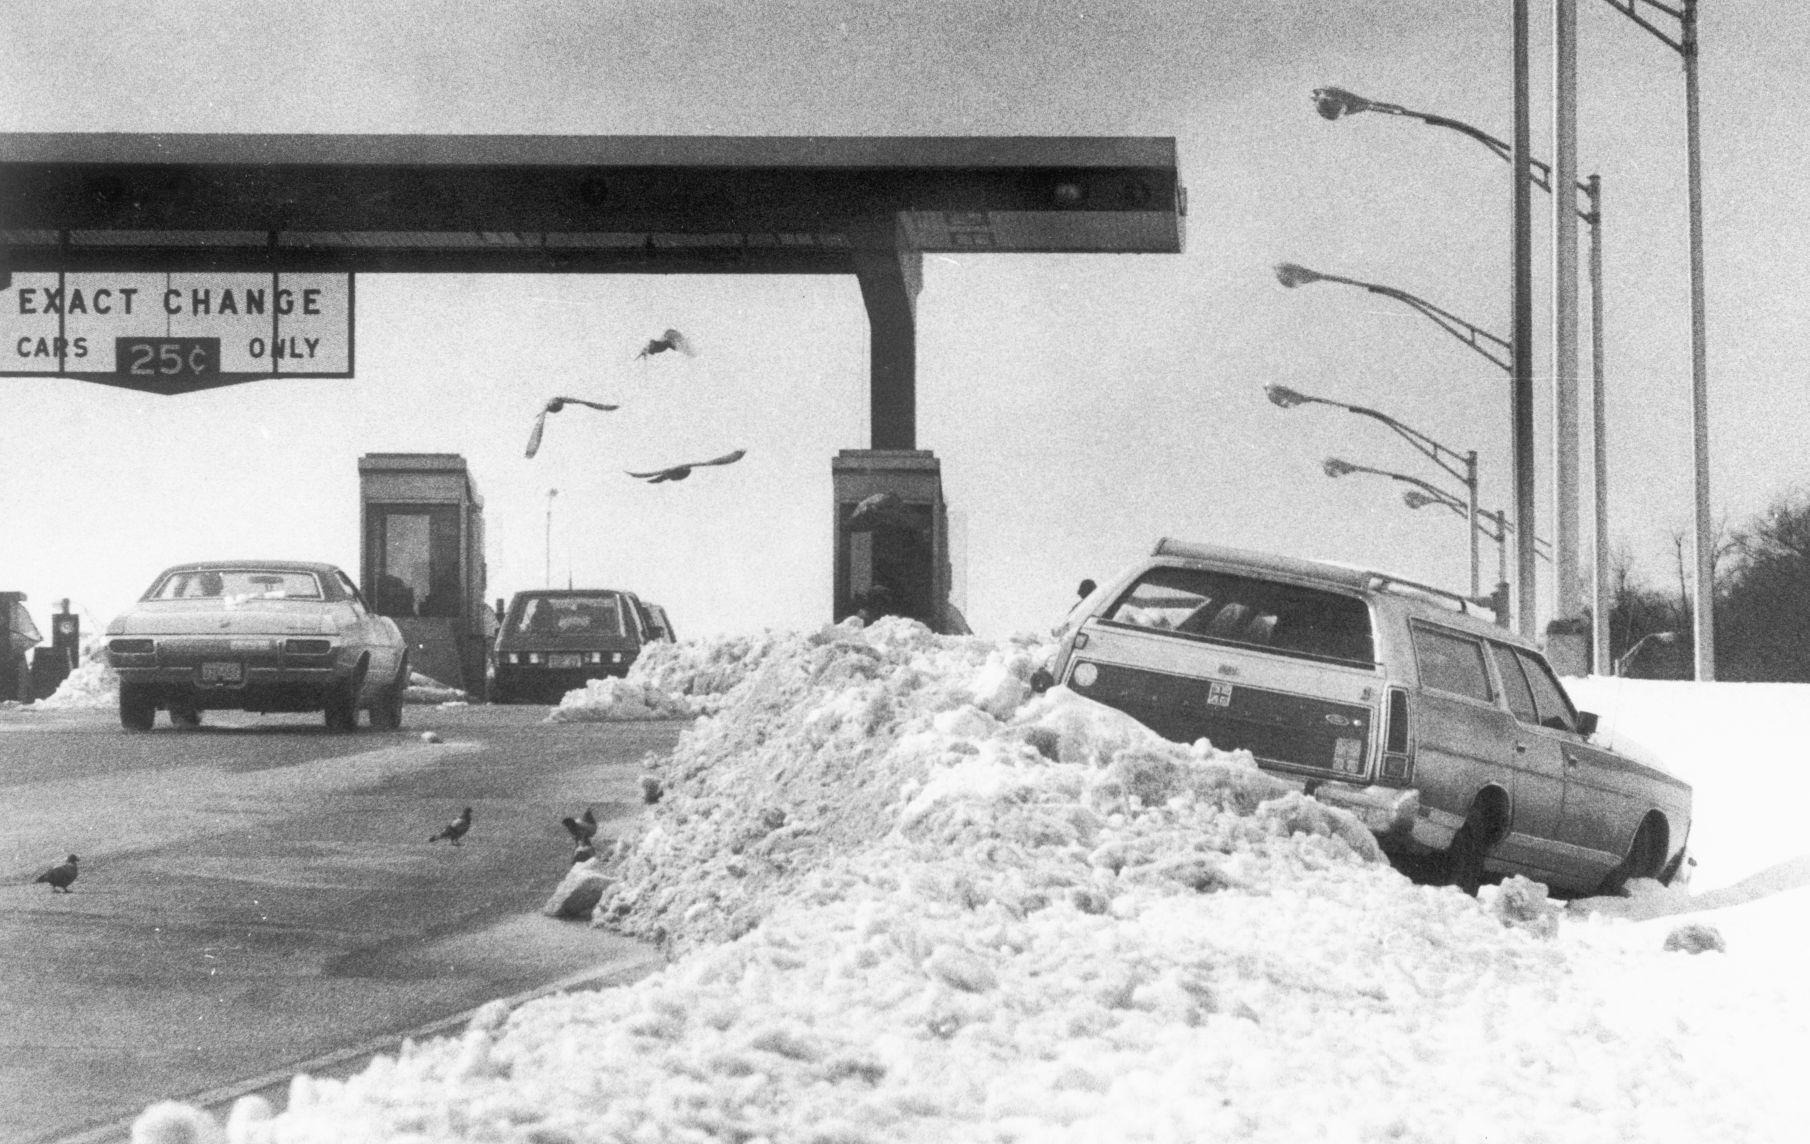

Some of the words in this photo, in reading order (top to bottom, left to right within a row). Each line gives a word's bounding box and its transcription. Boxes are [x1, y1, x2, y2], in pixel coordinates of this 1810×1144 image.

[18, 288, 139, 315] EXACT
[163, 288, 322, 316] CHANGE
[16, 336, 89, 359] CARS
[129, 343, 207, 376] 25¢
[249, 336, 321, 360] ONLY
